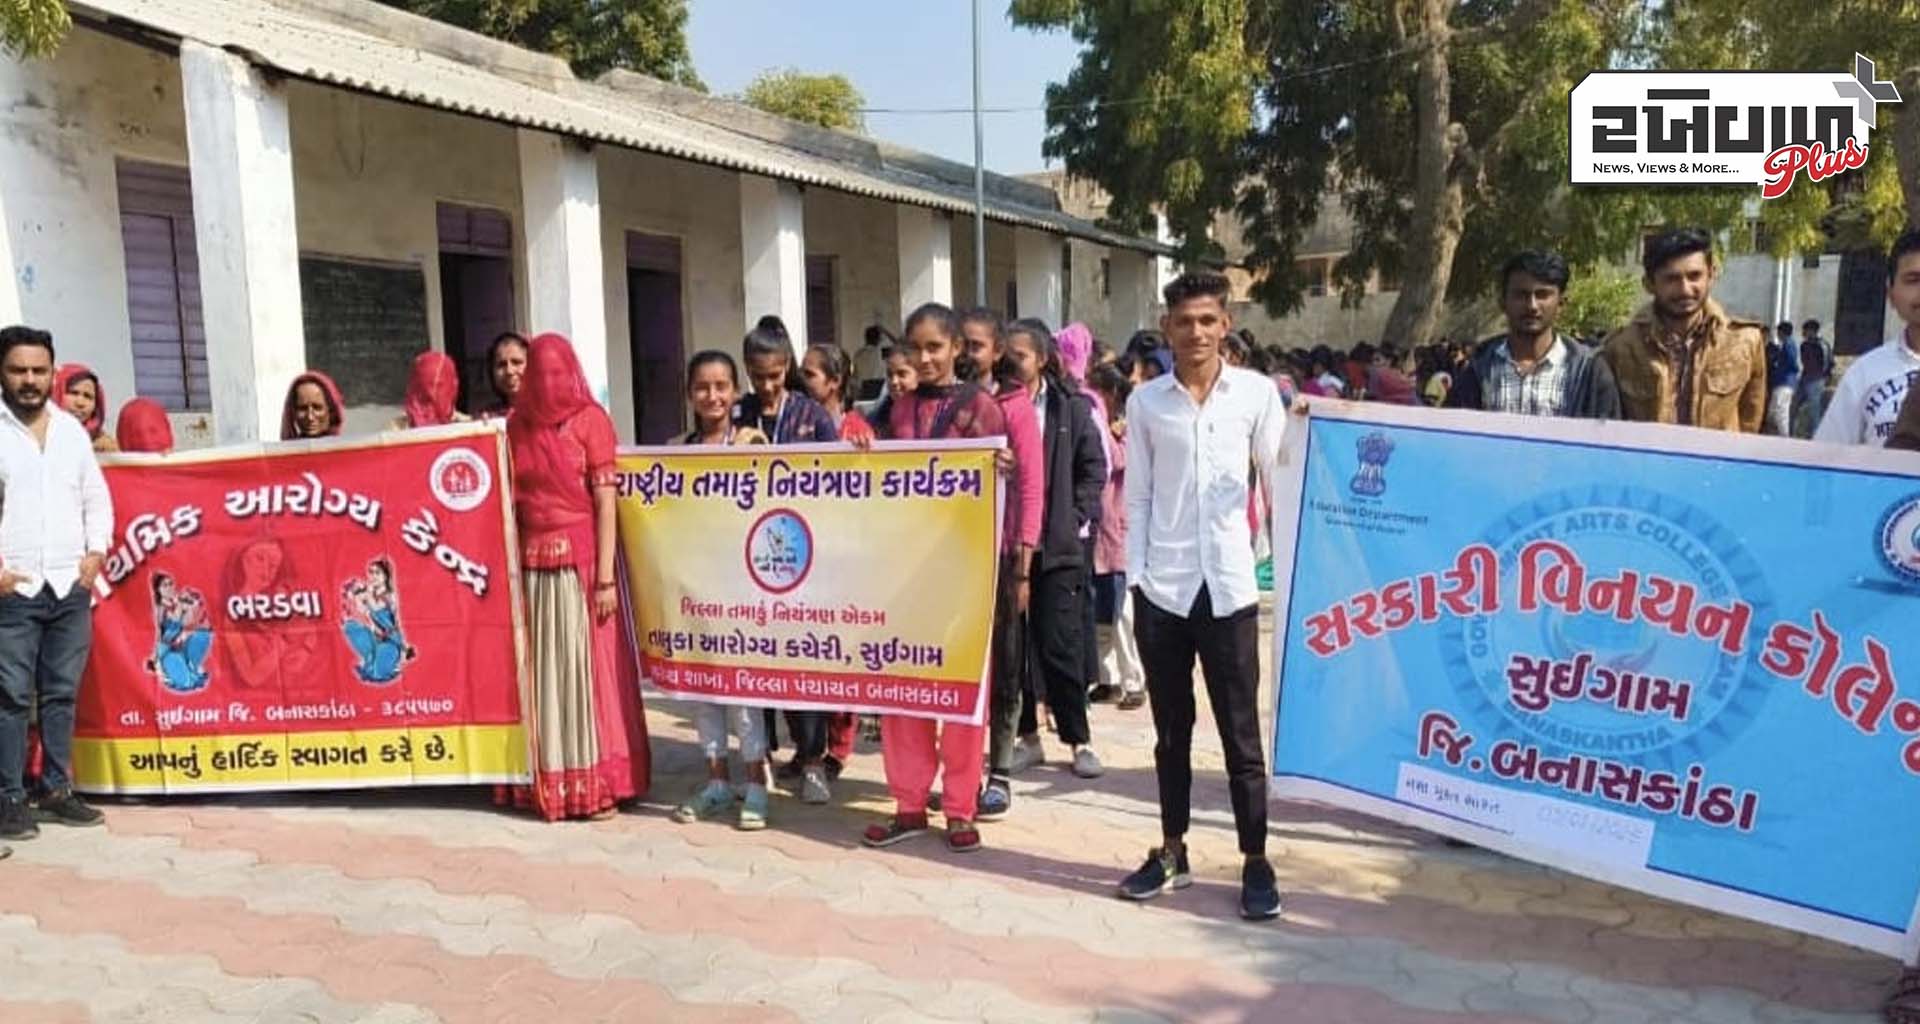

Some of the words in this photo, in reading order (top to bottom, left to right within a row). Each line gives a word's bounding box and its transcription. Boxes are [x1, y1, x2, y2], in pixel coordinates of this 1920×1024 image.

[615, 462, 684, 505] રાષ્ટ્રીય
[767, 459, 872, 499] નિયંત્રણ
[881, 457, 982, 497] કાર્યક્રમ
[224, 472, 382, 531] આરોગ્ય
[402, 508, 489, 597] કેન્દ્ર
[1565, 512, 1630, 535] ARTS
[227, 588, 324, 621] ભરડવા
[681, 596, 723, 619] જિલ્લા
[773, 604, 835, 626] નિયંત્રણ
[841, 607, 886, 627] એકમ
[1304, 546, 1500, 657] સરકારી
[1519, 541, 1751, 656] વિનયન
[700, 628, 778, 658] આરોગ્ય
[785, 632, 852, 665] કચેરી,
[861, 637, 943, 671] સુઈગામ
[736, 670, 788, 694] જિલ્લા
[795, 672, 860, 698] પંચાયત
[867, 680, 959, 707] બનાસકાંઠા
[1507, 654, 1690, 720] સુઈગામ
[120, 711, 145, 726] તા.
[229, 702, 256, 722] જિ.
[266, 698, 357, 720] બનાસકાંઠા
[130, 744, 203, 778] આપનું
[212, 743, 279, 769] હાર્દિક
[291, 746, 367, 767] સ્વાગત
[380, 735, 413, 762] કરે
[425, 734, 455, 762] છે.
